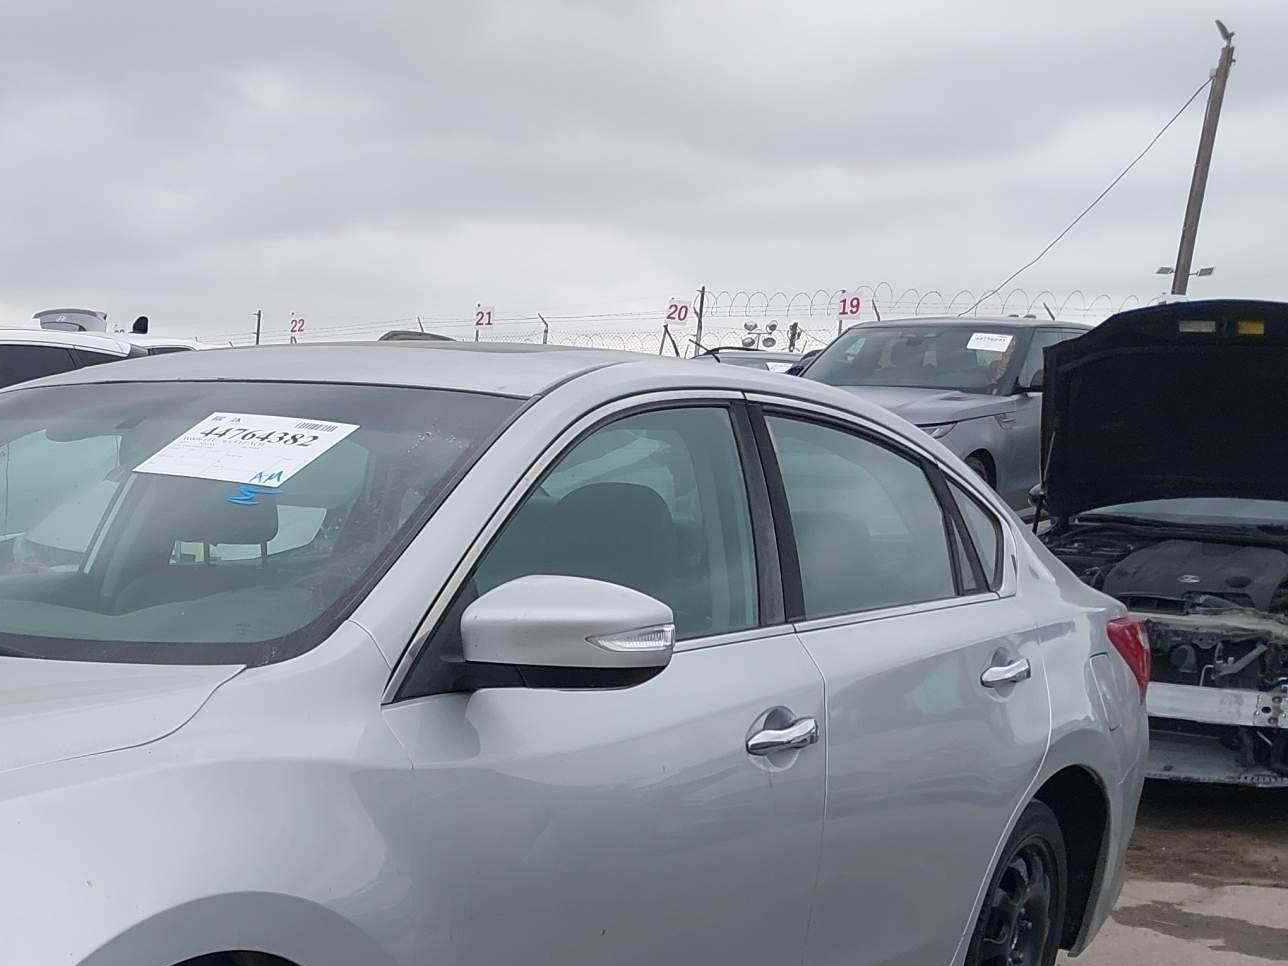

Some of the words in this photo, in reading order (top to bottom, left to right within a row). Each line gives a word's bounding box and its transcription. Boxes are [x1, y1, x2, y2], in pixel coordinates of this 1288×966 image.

[666, 304, 688, 321] 20
[839, 297, 860, 315] 19
[290, 319, 305, 333] 22
[475, 311, 493, 326] 21
[200, 425, 319, 447] 44764382
